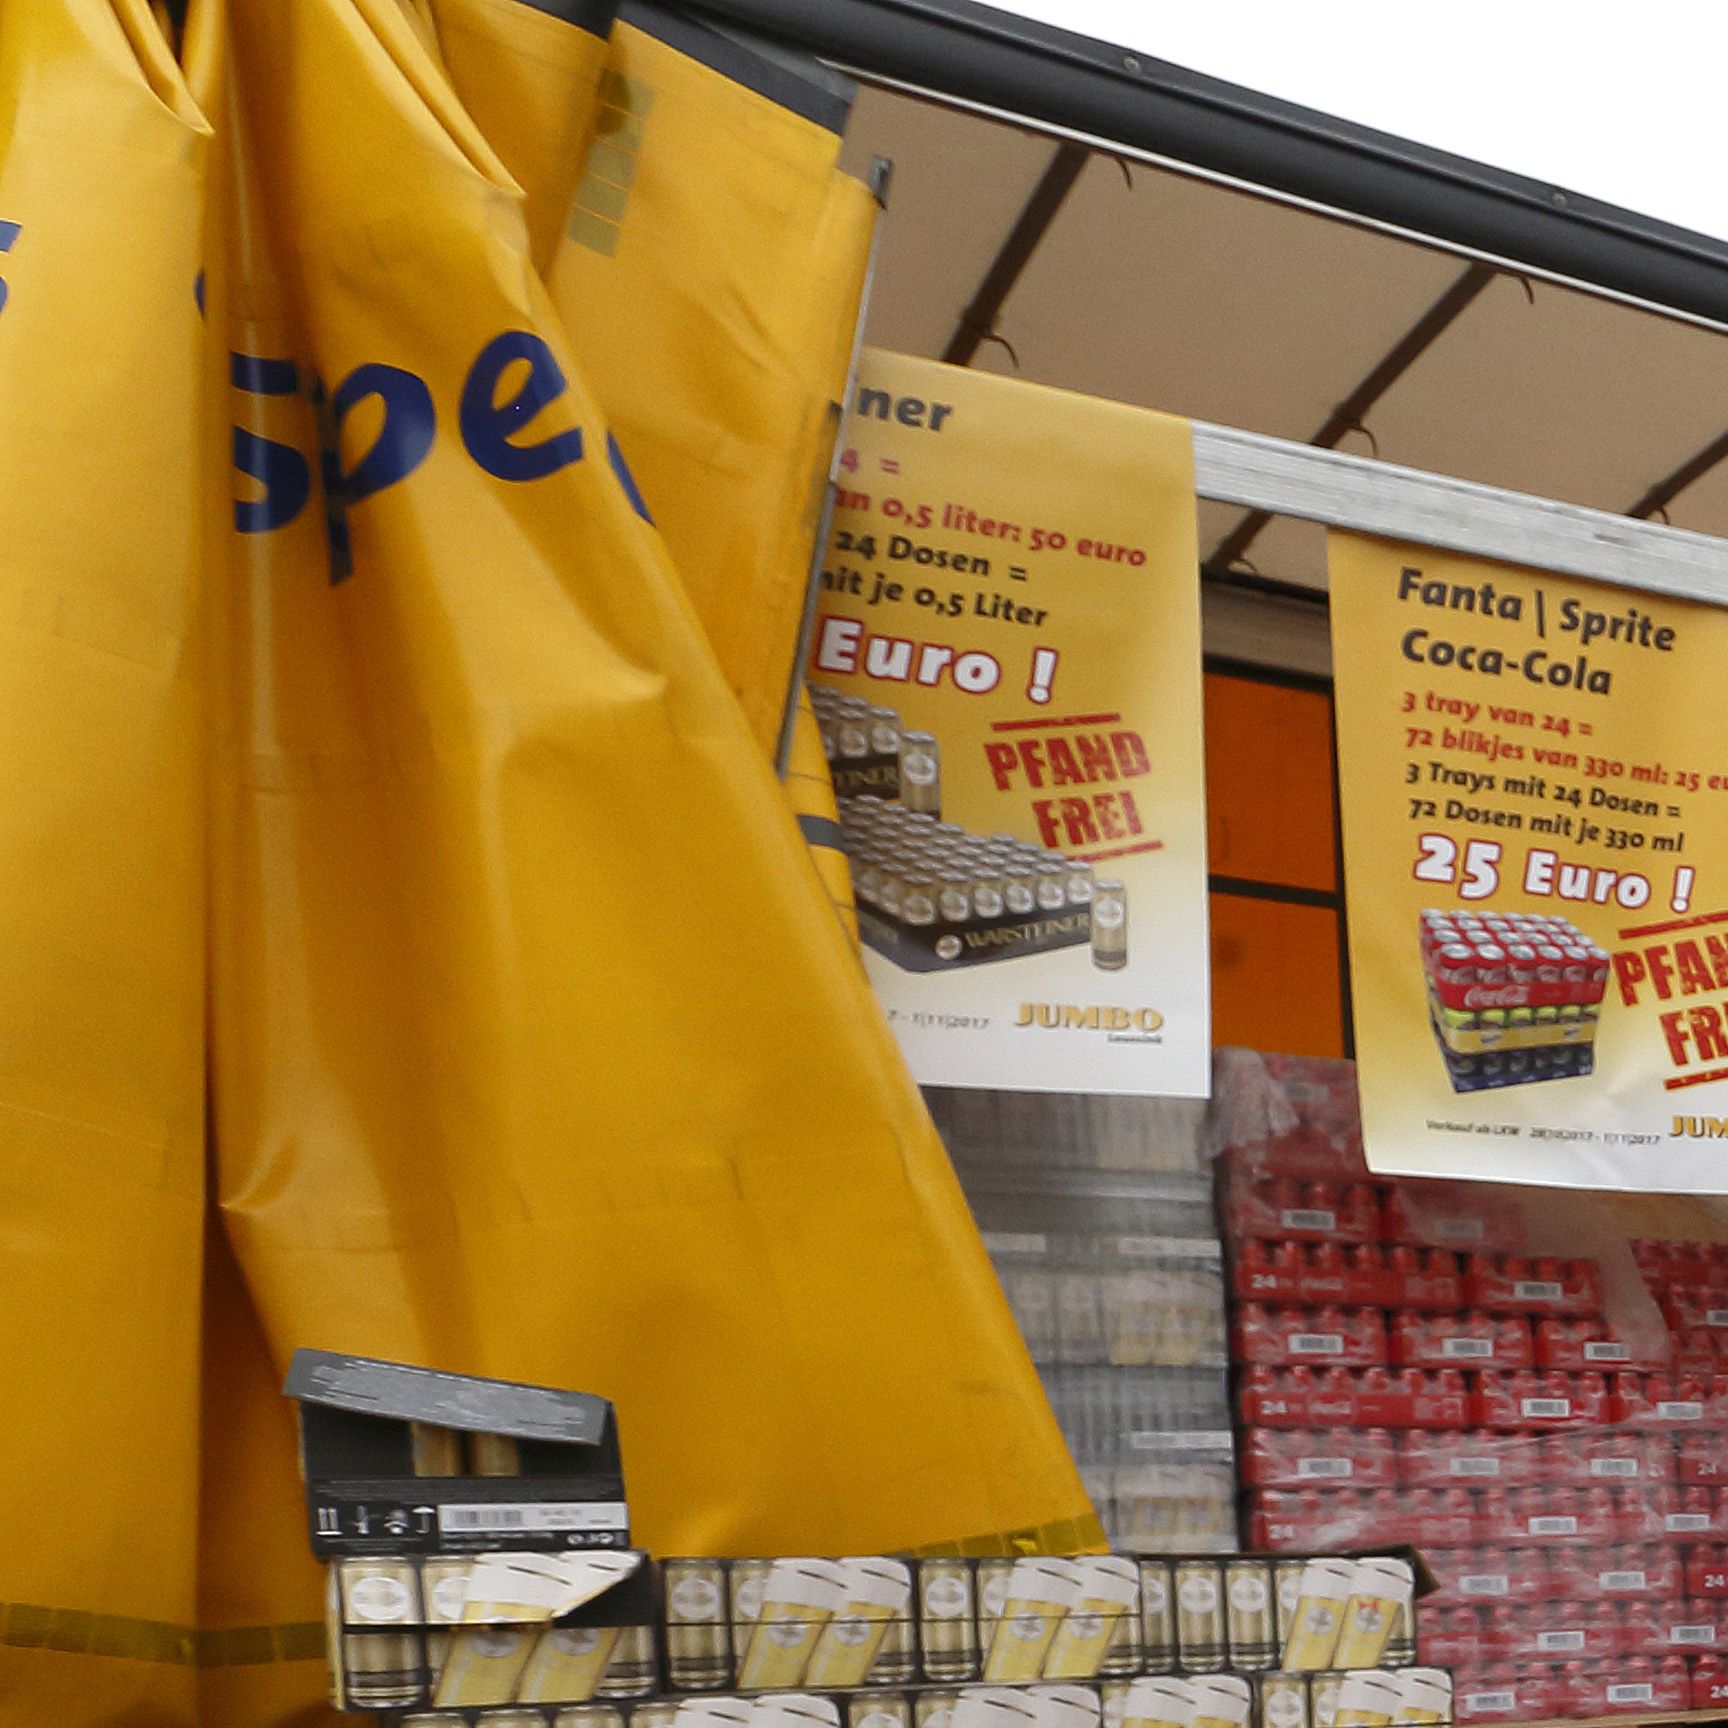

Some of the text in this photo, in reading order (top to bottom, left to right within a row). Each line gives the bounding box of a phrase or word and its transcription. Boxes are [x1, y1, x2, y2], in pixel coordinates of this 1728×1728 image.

[835, 530, 990, 576] 24 Dosen
[942, 503, 1021, 542] liter:
[1030, 528, 1067, 552] 50
[1077, 538, 1147, 567] euro
[870, 573, 904, 605] je
[974, 592, 1048, 627] Liter
[1398, 567, 1675, 651] Fanta Sprite
[816, 616, 1000, 694] Euro
[1401, 629, 1612, 695] Coca-Cola
[1426, 691, 1571, 736] tray van 24
[984, 731, 1151, 792] PFAND
[1405, 728, 1432, 748] 72
[1442, 729, 1524, 762] blikjes
[1533, 748, 1577, 769] van
[1584, 756, 1623, 777] 330
[1675, 771, 1700, 791] 25
[1429, 762, 1658, 817] Trays mit 24 Dosen
[1032, 790, 1144, 849] FREI
[1409, 798, 1684, 852] 72 Dosen mit je 330 ml
[1414, 834, 1650, 909] 25 Euro
[1014, 1002, 1163, 1032] JUMBO
